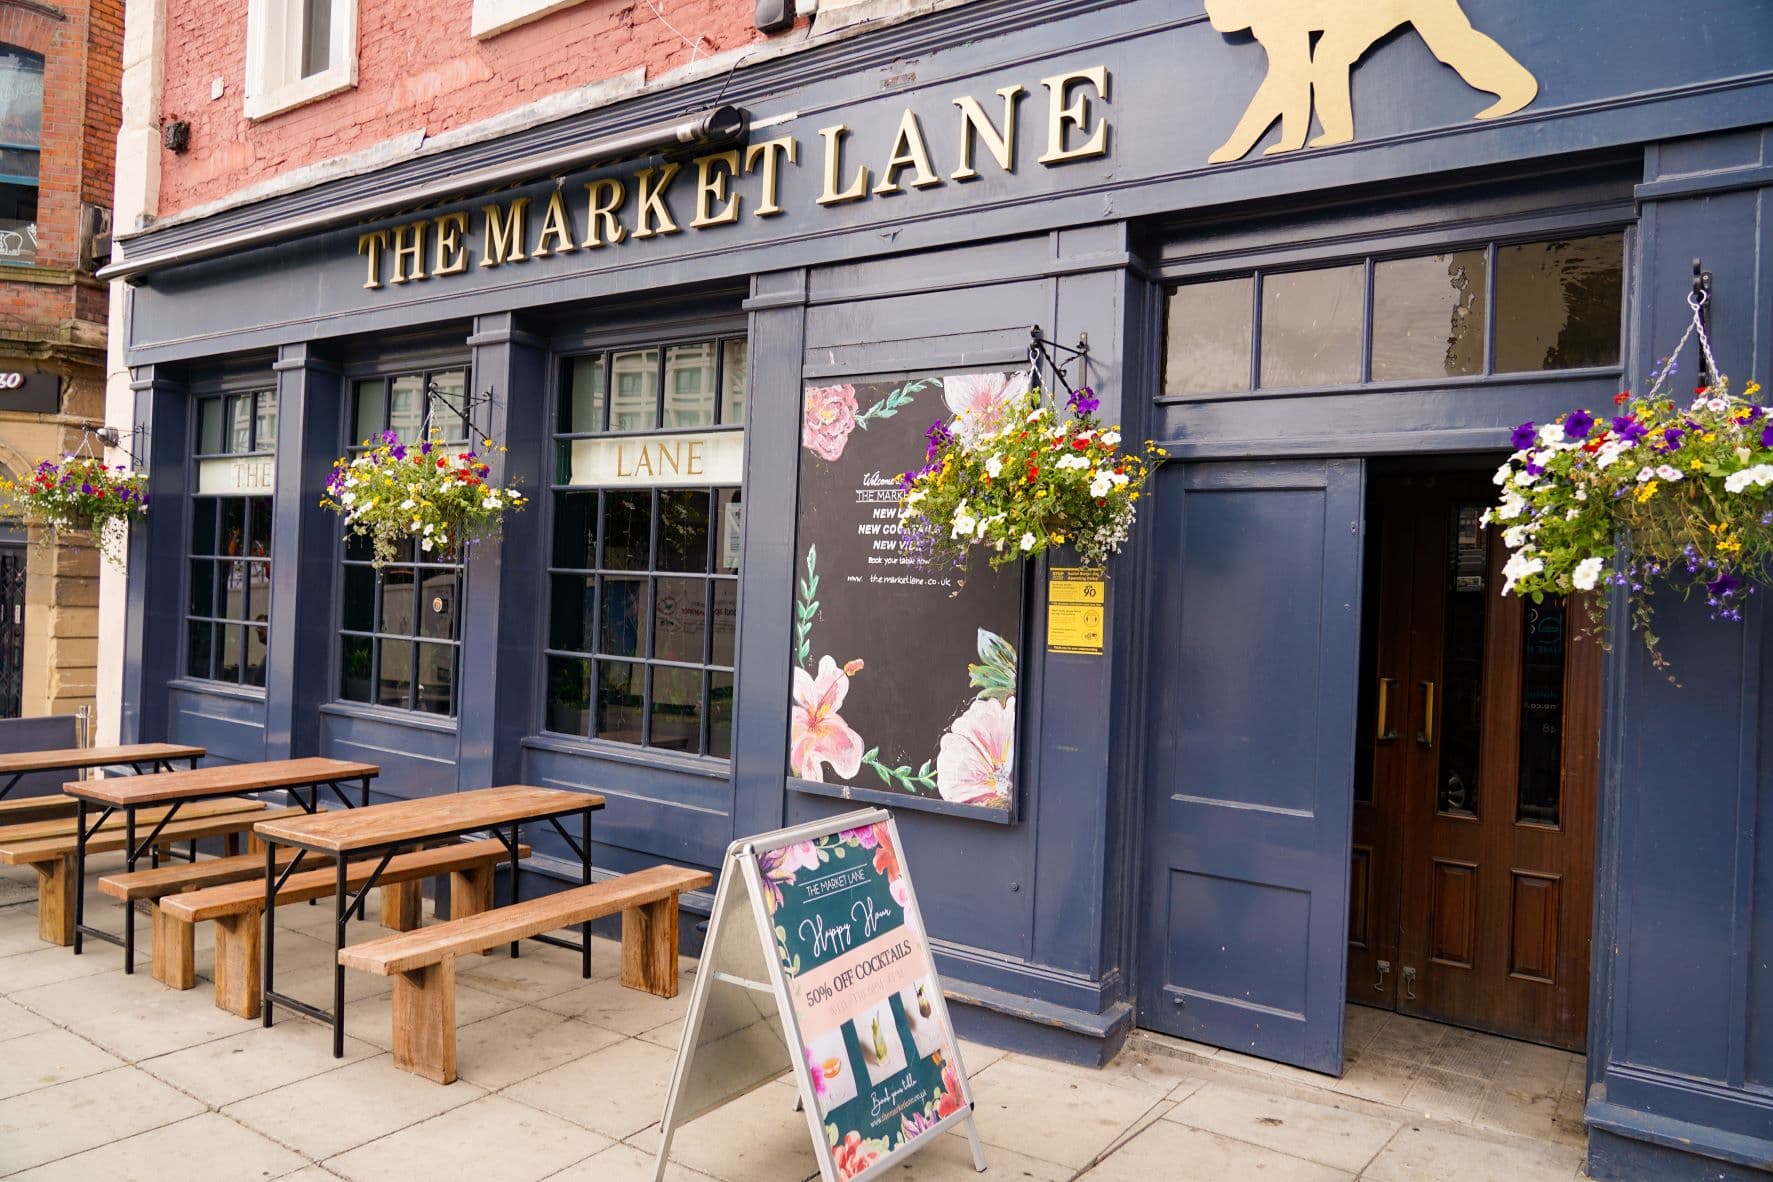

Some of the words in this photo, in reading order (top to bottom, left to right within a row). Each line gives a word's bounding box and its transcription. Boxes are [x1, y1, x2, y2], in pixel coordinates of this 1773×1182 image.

[358, 211, 470, 289] THE
[479, 136, 797, 268] MARKET
[816, 65, 1109, 206] LANE
[616, 440, 704, 477] LANE
[233, 463, 272, 488] THE
[857, 490, 875, 502] THE
[877, 490, 909, 502] MARKE
[873, 508, 897, 519] NEW
[858, 524, 881, 535] NEW
[873, 540, 897, 550] NEW
[1083, 588, 1097, 598] 90
[806, 885, 820, 897] THE
[820, 874, 848, 893] MARKET
[847, 869, 866, 884] LANE
[798, 913, 851, 958] Happy
[850, 896, 892, 938] Hour
[806, 980, 833, 1008] 50%
[833, 968, 854, 993] OFF
[855, 939, 912, 980] COCKTAILS
